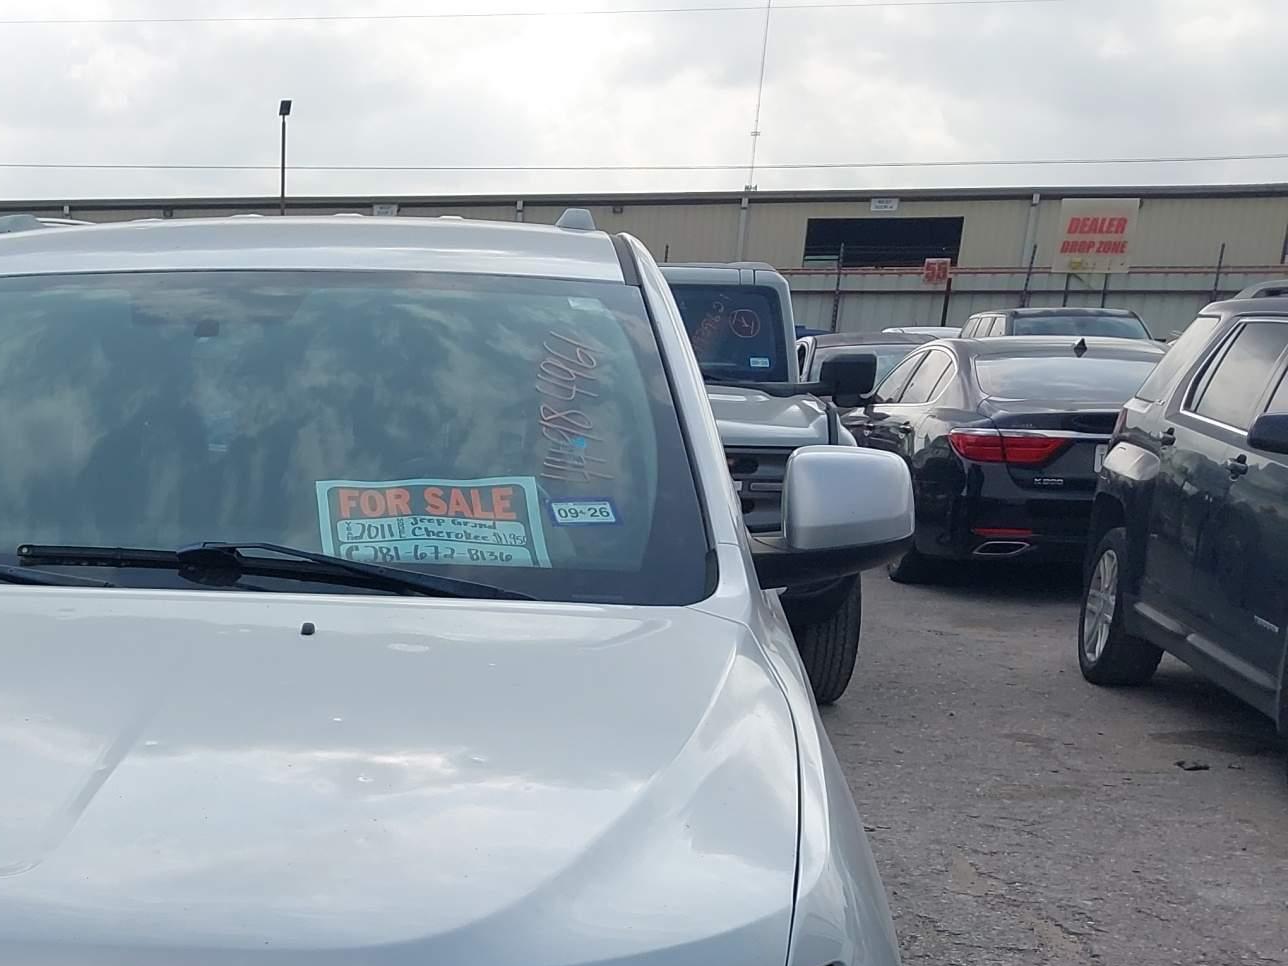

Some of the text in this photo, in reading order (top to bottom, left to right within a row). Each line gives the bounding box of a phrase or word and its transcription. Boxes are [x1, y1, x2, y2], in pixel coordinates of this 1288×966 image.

[1066, 217, 1129, 235] DEALER
[1060, 240, 1129, 254] DROP ZONE
[339, 486, 518, 520] FOR SALE
[353, 521, 395, 540] 2011
[411, 526, 491, 542] Cherokee
